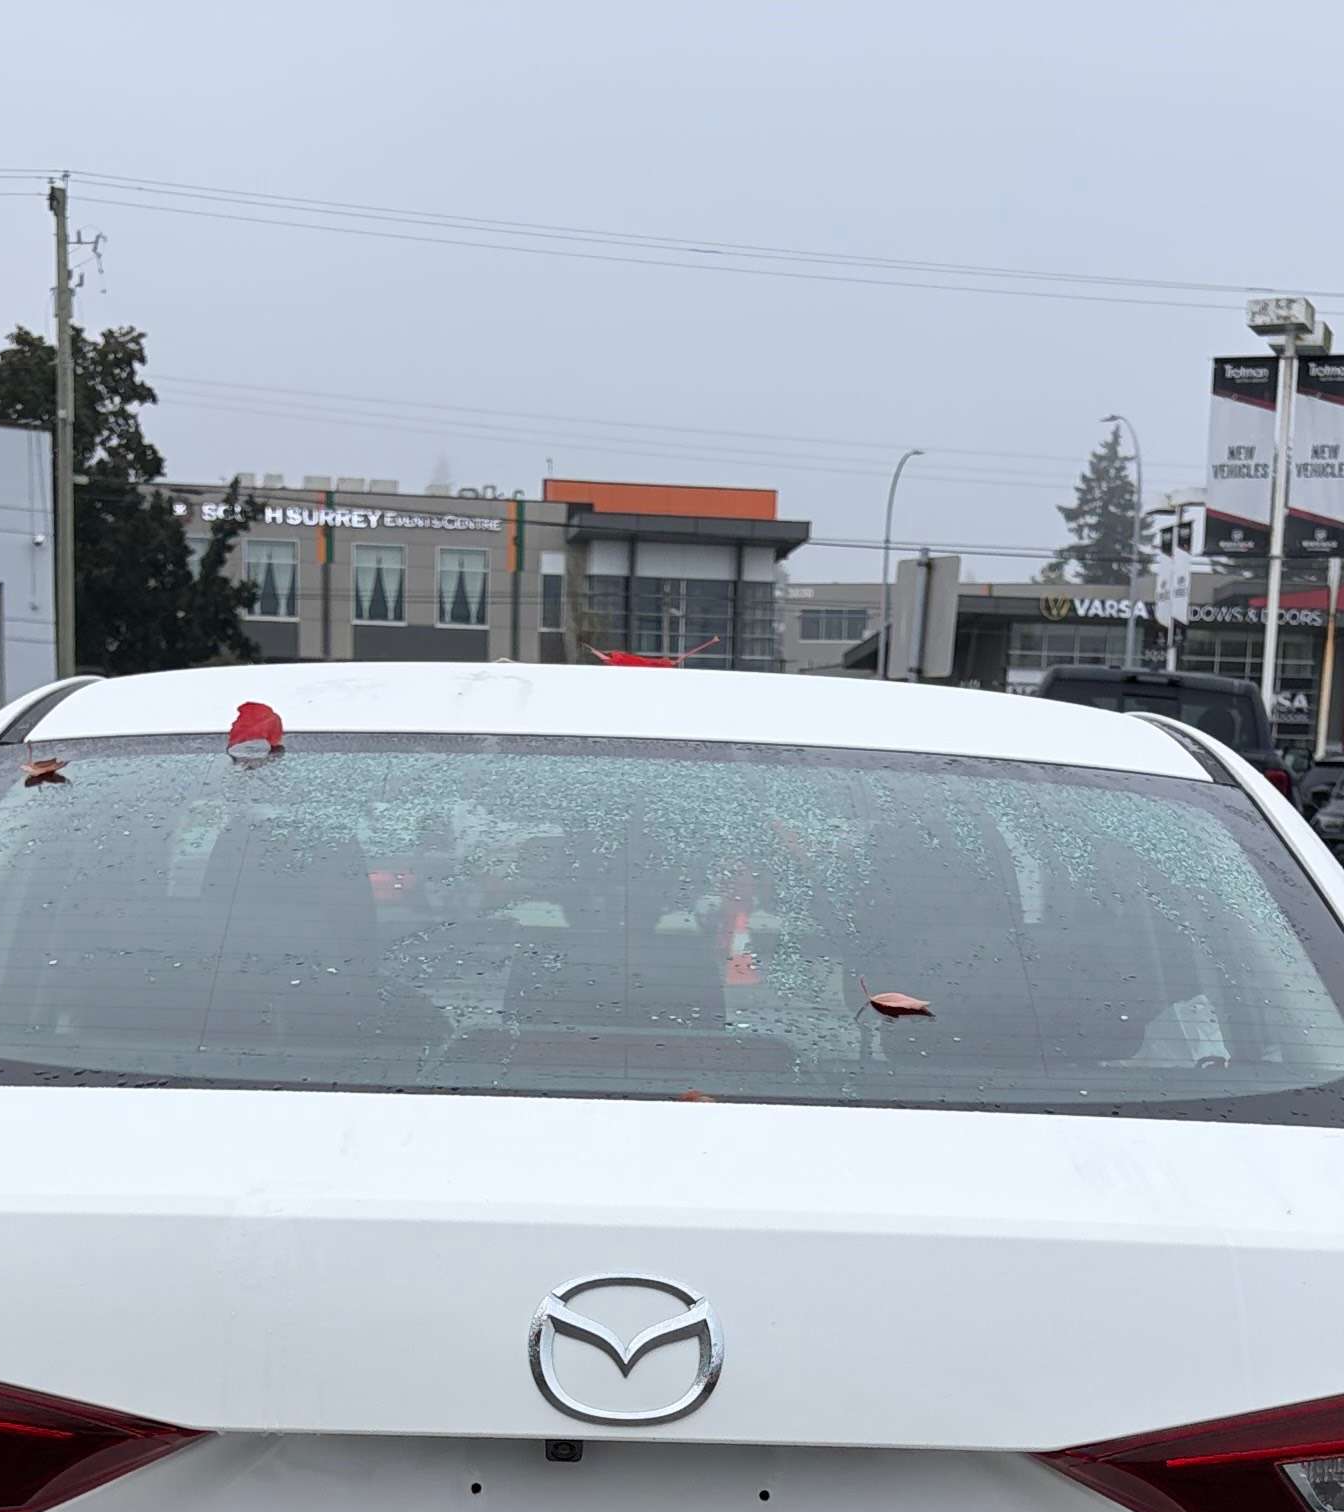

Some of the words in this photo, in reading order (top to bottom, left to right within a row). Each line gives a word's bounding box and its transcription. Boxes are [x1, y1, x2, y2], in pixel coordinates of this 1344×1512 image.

[1227, 446, 1256, 461] NEW
[1311, 444, 1340, 460] NEW
[1212, 463, 1270, 479] VEHICLES
[286, 506, 383, 529] SURREY
[1074, 597, 1149, 619] VARSA
